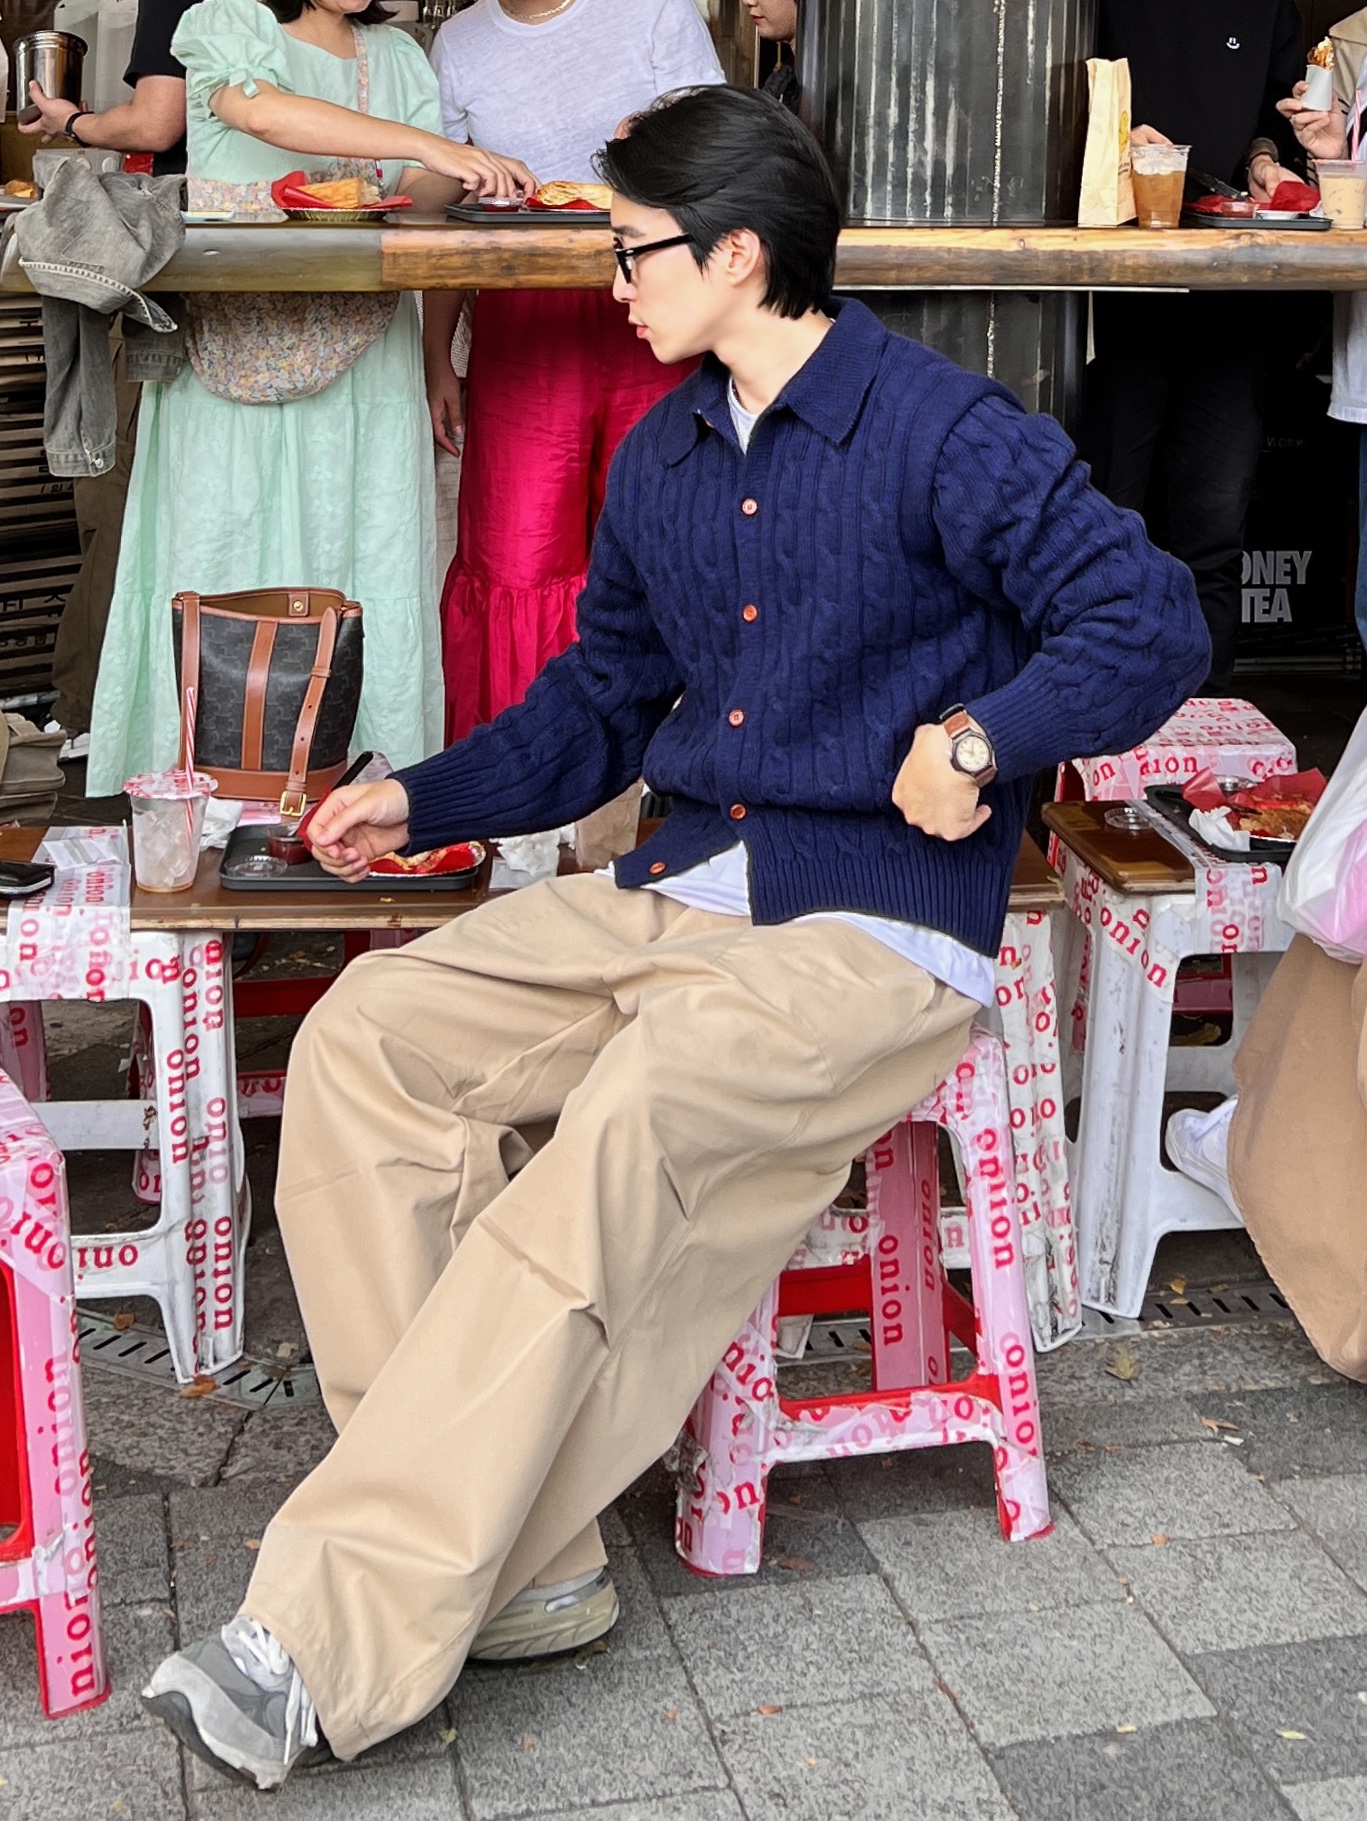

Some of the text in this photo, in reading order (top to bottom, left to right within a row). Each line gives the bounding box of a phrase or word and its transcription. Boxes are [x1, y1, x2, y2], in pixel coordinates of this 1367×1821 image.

[182, 967, 201, 1081] onion
[166, 1049, 189, 1164] onion
[206, 1097, 230, 1185] onio
[213, 1216, 234, 1331] onion
[878, 1234, 910, 1346] onion
[921, 1178, 936, 1292] onion
[1005, 1344, 1038, 1457] onio
